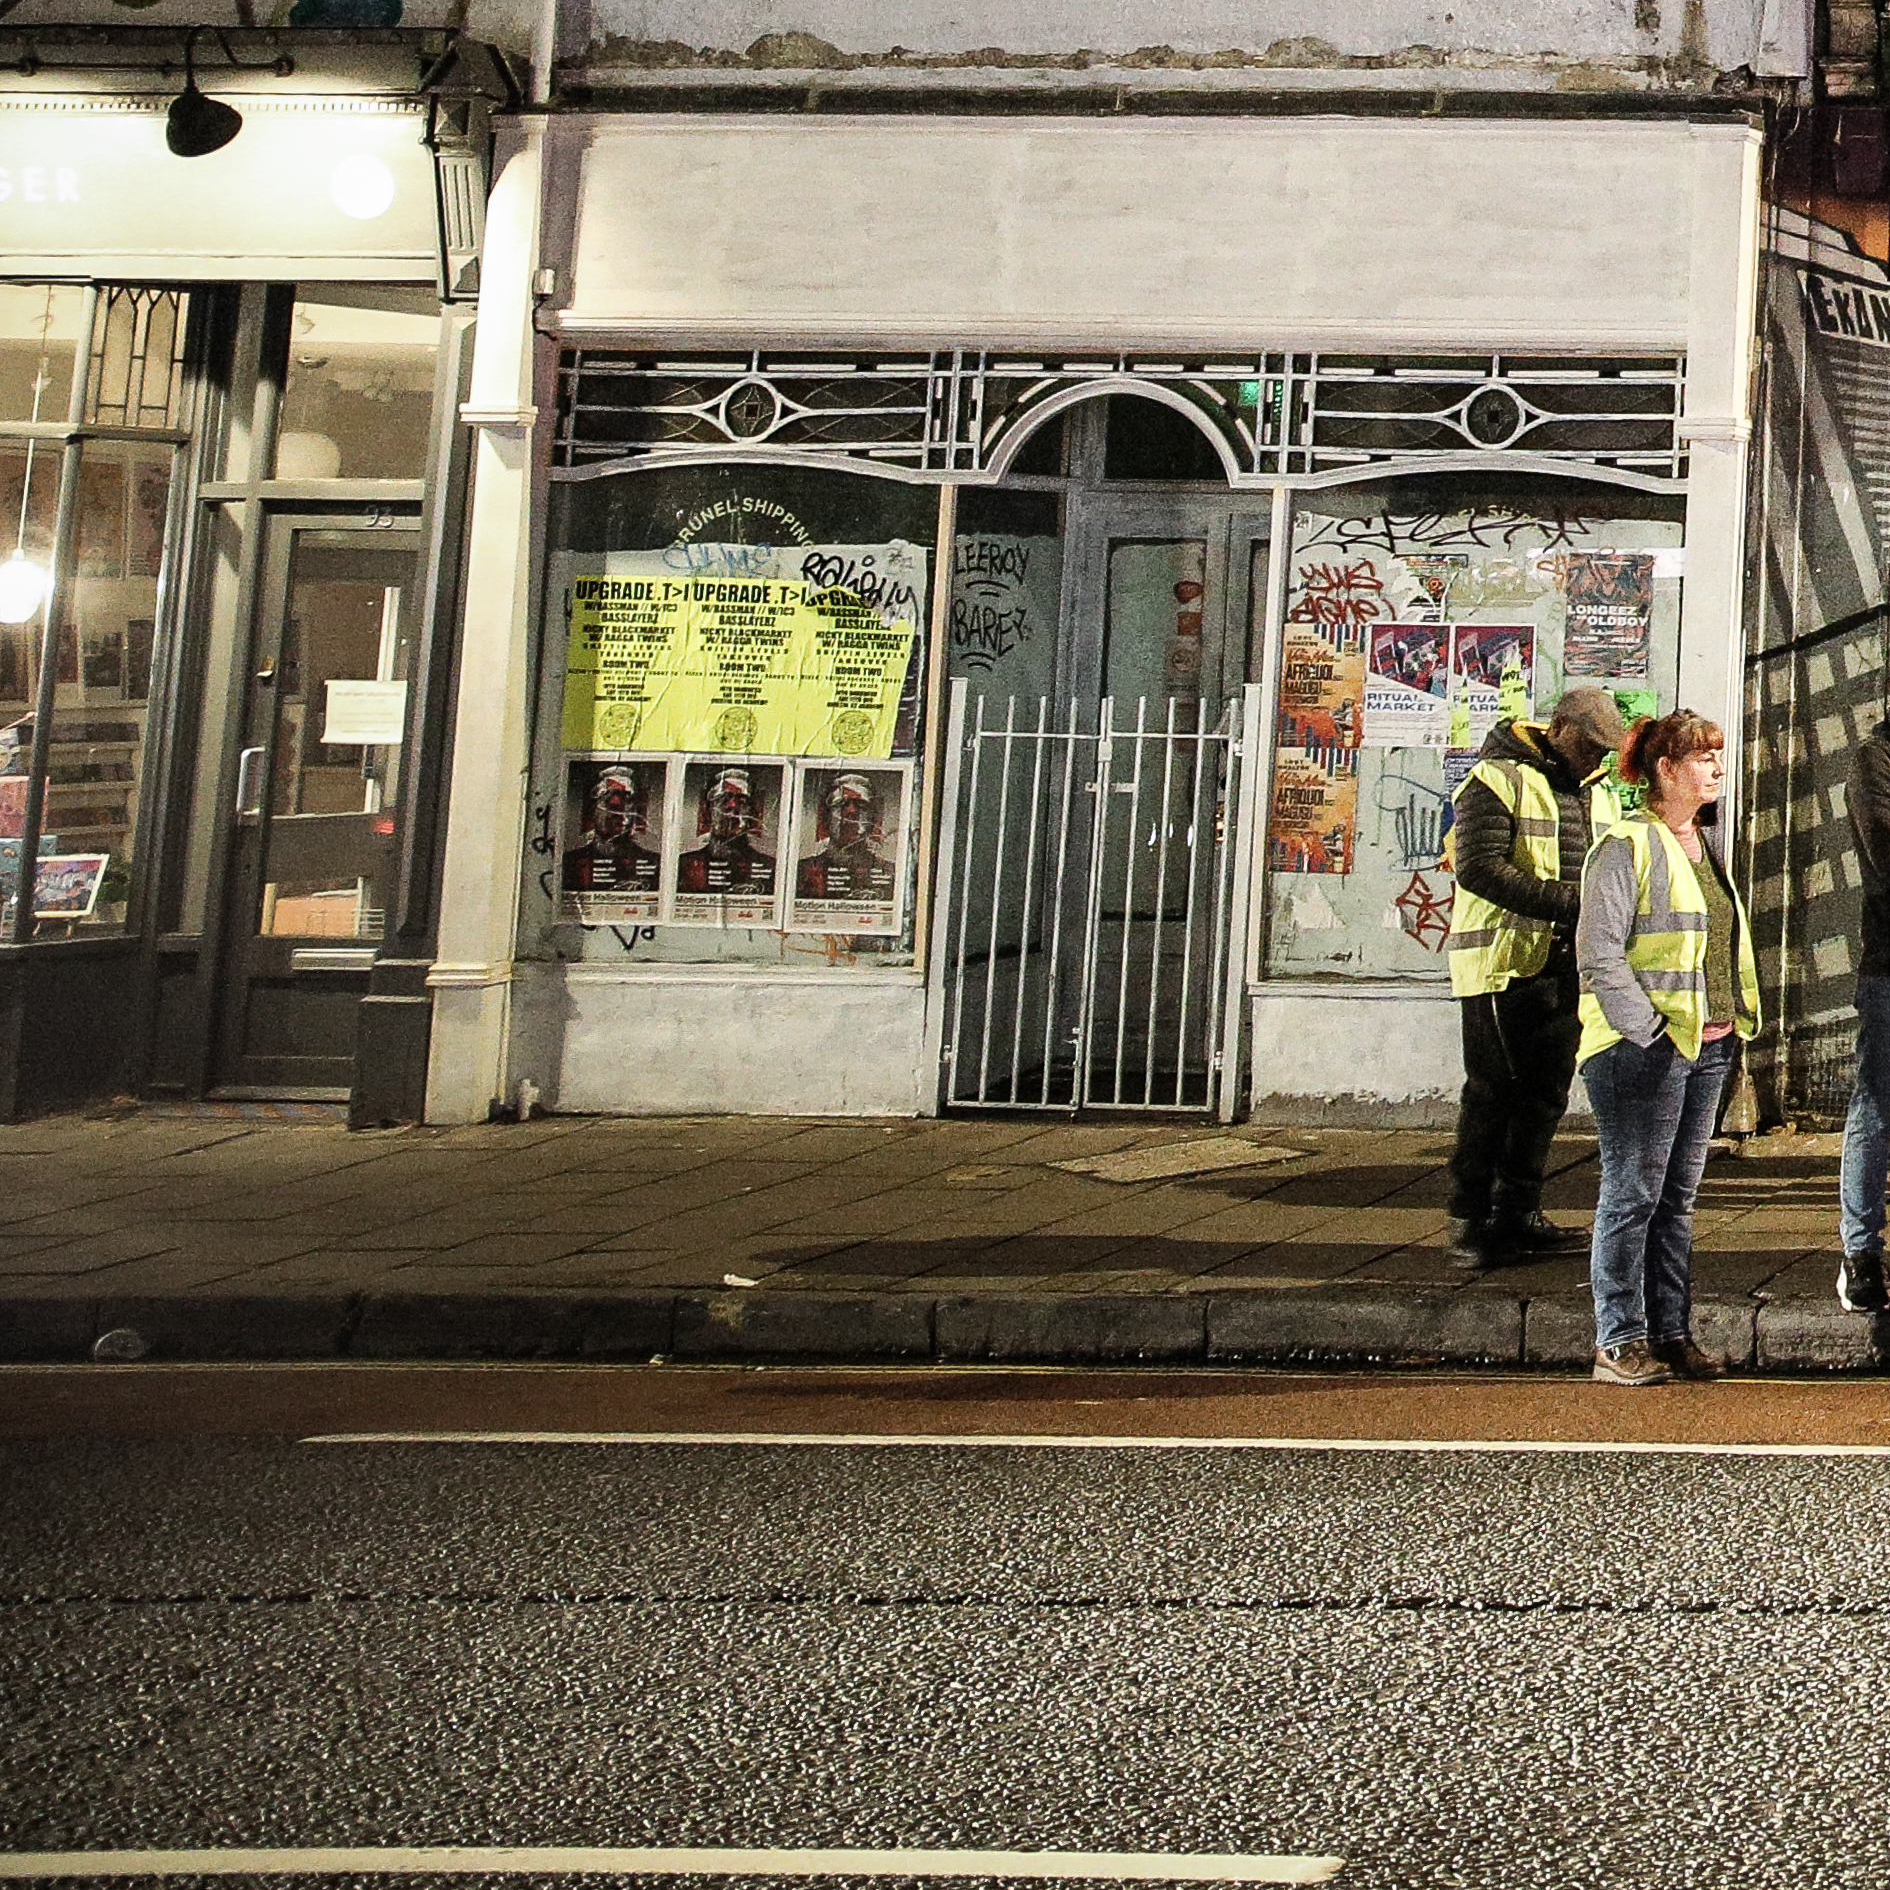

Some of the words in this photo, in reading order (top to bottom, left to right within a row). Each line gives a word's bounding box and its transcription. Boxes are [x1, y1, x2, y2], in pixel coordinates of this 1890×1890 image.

[576, 580, 654, 601] UPGRADE
[694, 582, 771, 604] UPGRADE
[1453, 694, 1499, 703] RTUA
[1367, 702, 1435, 712] MARKET
[794, 901, 826, 910] Motion
